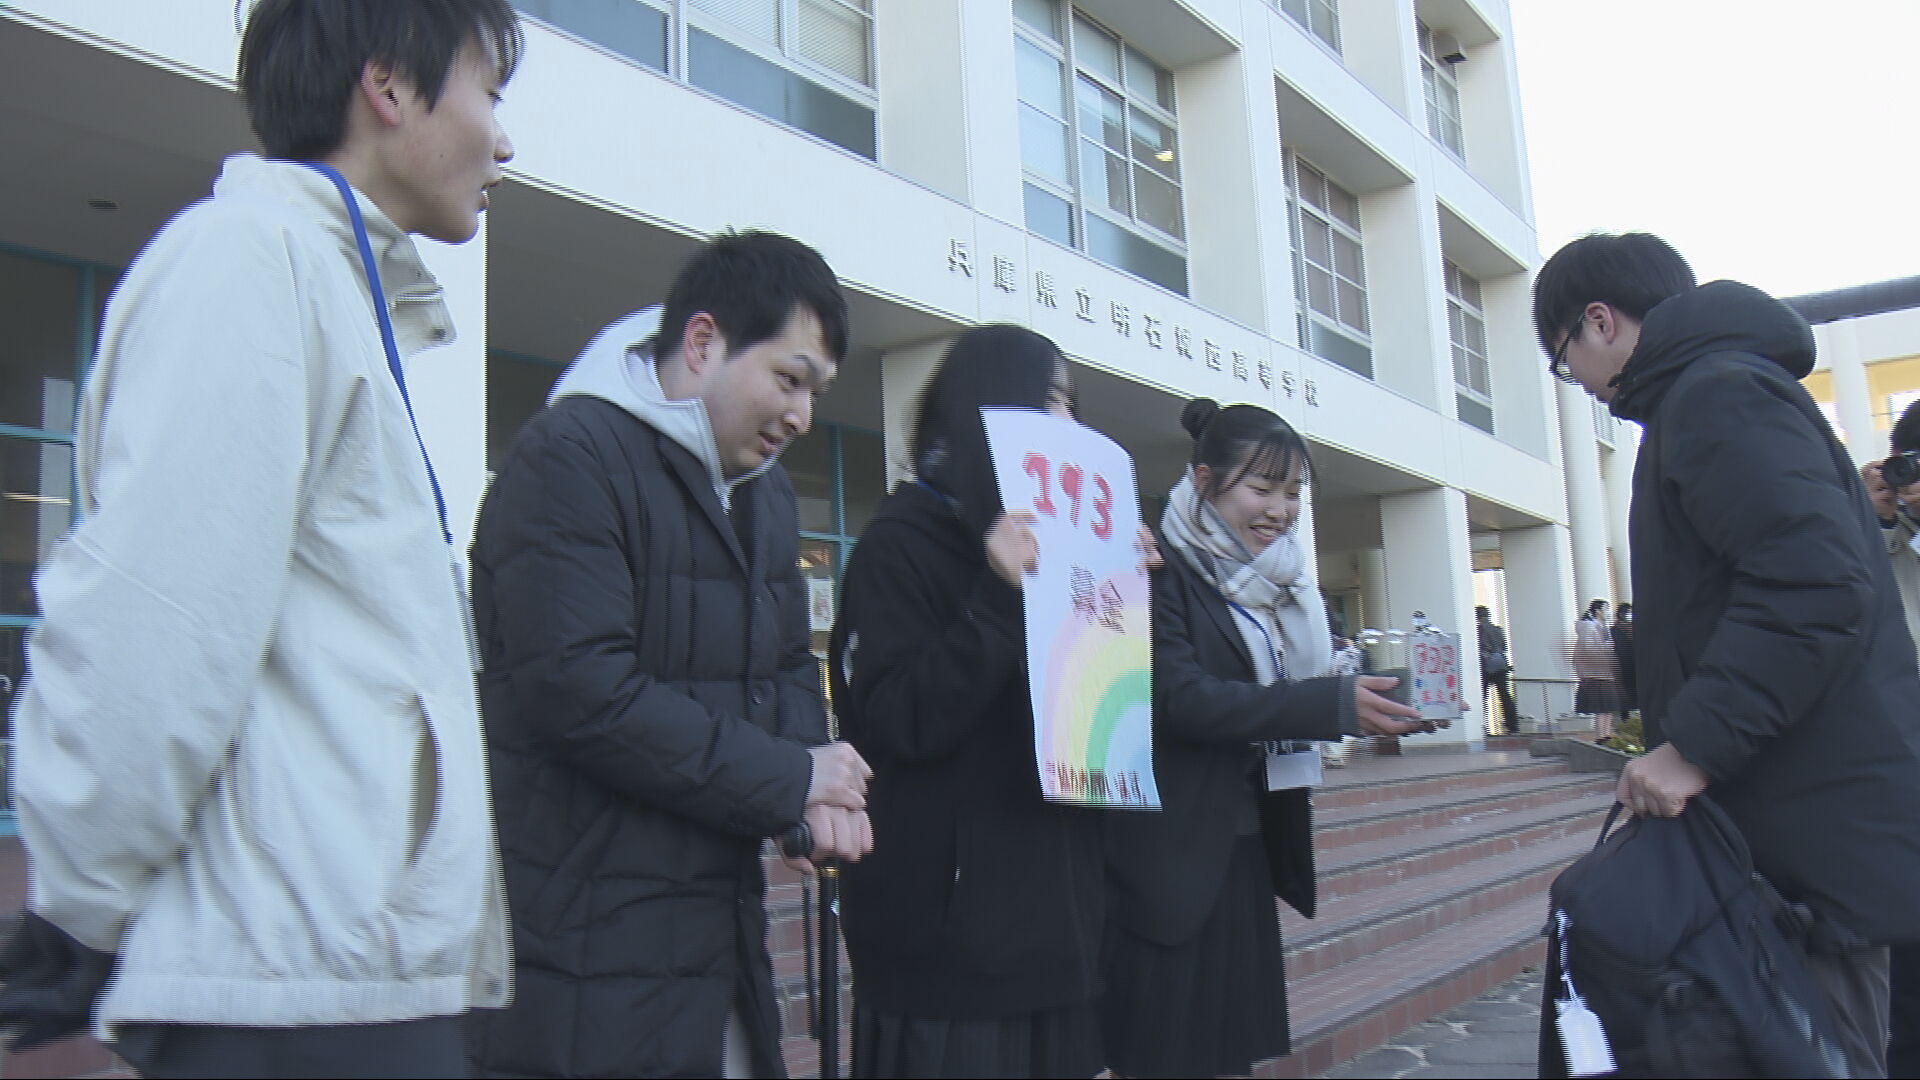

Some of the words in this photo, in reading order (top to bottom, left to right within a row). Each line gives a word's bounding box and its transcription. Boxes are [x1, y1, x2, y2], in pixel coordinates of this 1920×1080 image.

[947, 238, 1319, 407] 兵庫県立明石城西高等学校
[1023, 453, 1113, 541] 193
[1070, 565, 1126, 634] 募金
